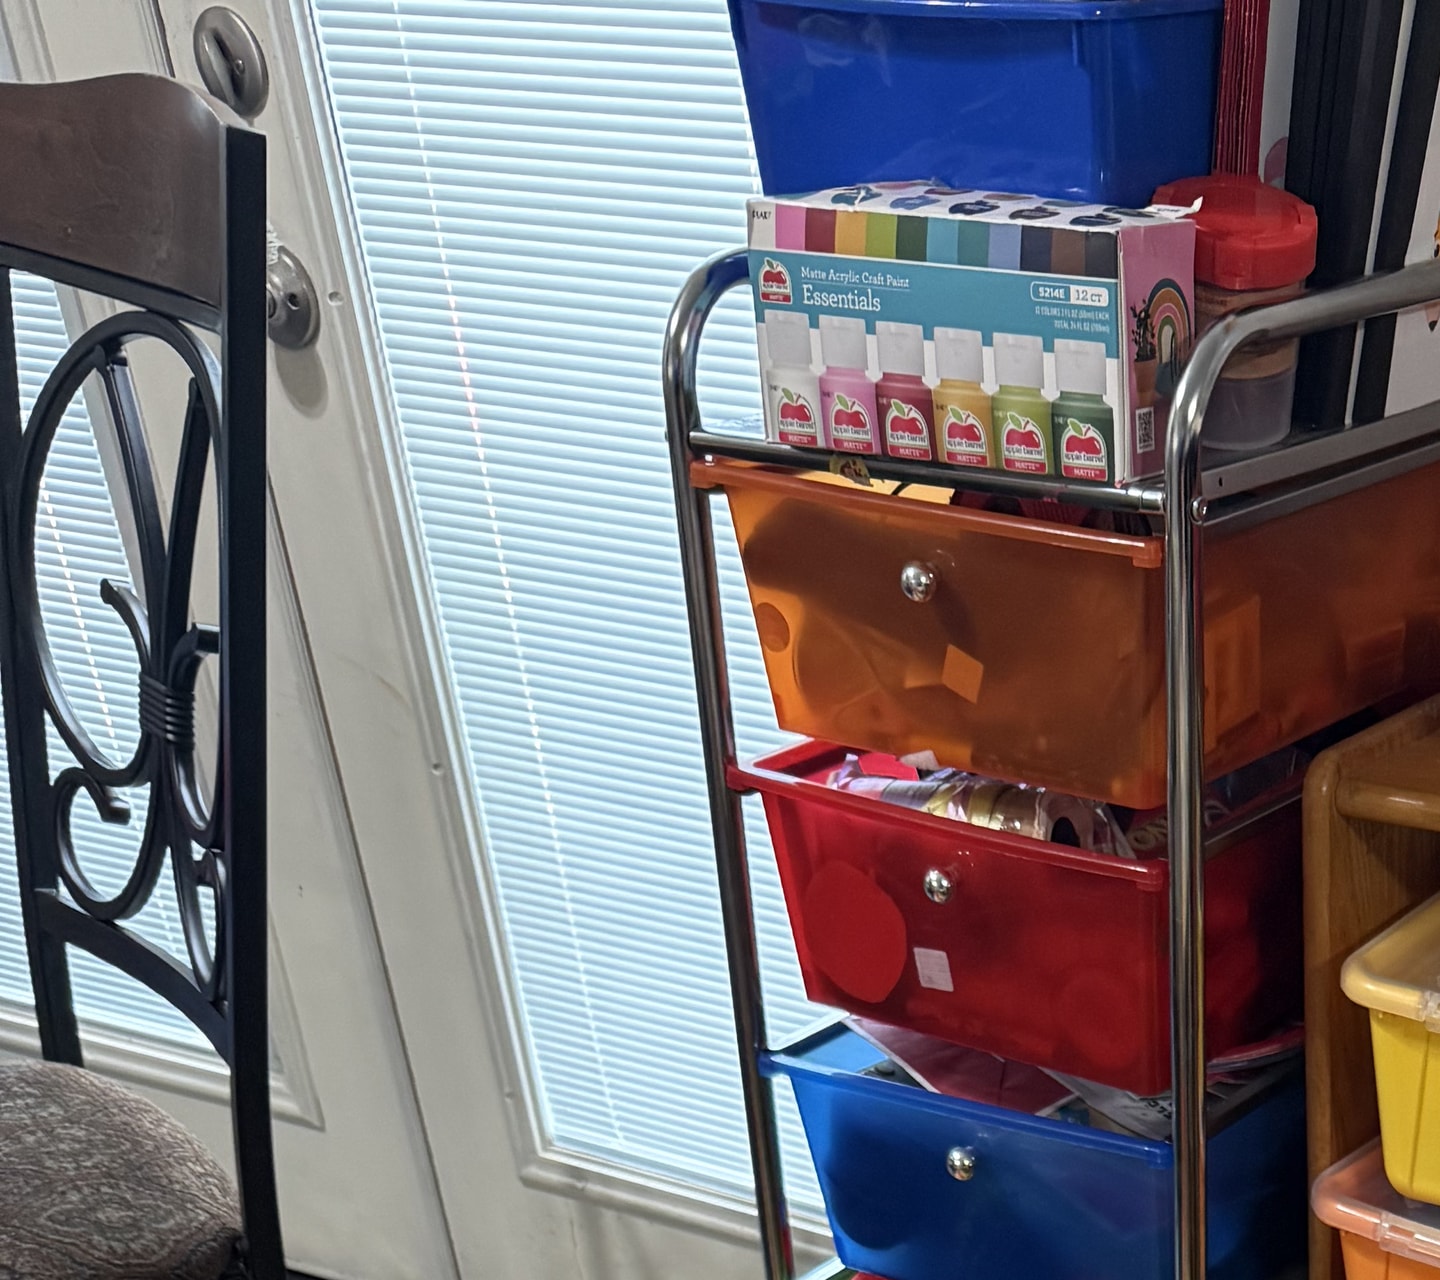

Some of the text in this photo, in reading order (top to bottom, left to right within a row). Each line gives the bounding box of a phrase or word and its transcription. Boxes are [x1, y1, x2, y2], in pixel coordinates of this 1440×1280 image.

[801, 266, 909, 287] Matte Acrylic Craft Paint
[803, 284, 881, 311] Essentials
[1075, 289, 1088, 301] 12
[1091, 293, 1102, 303] CT
